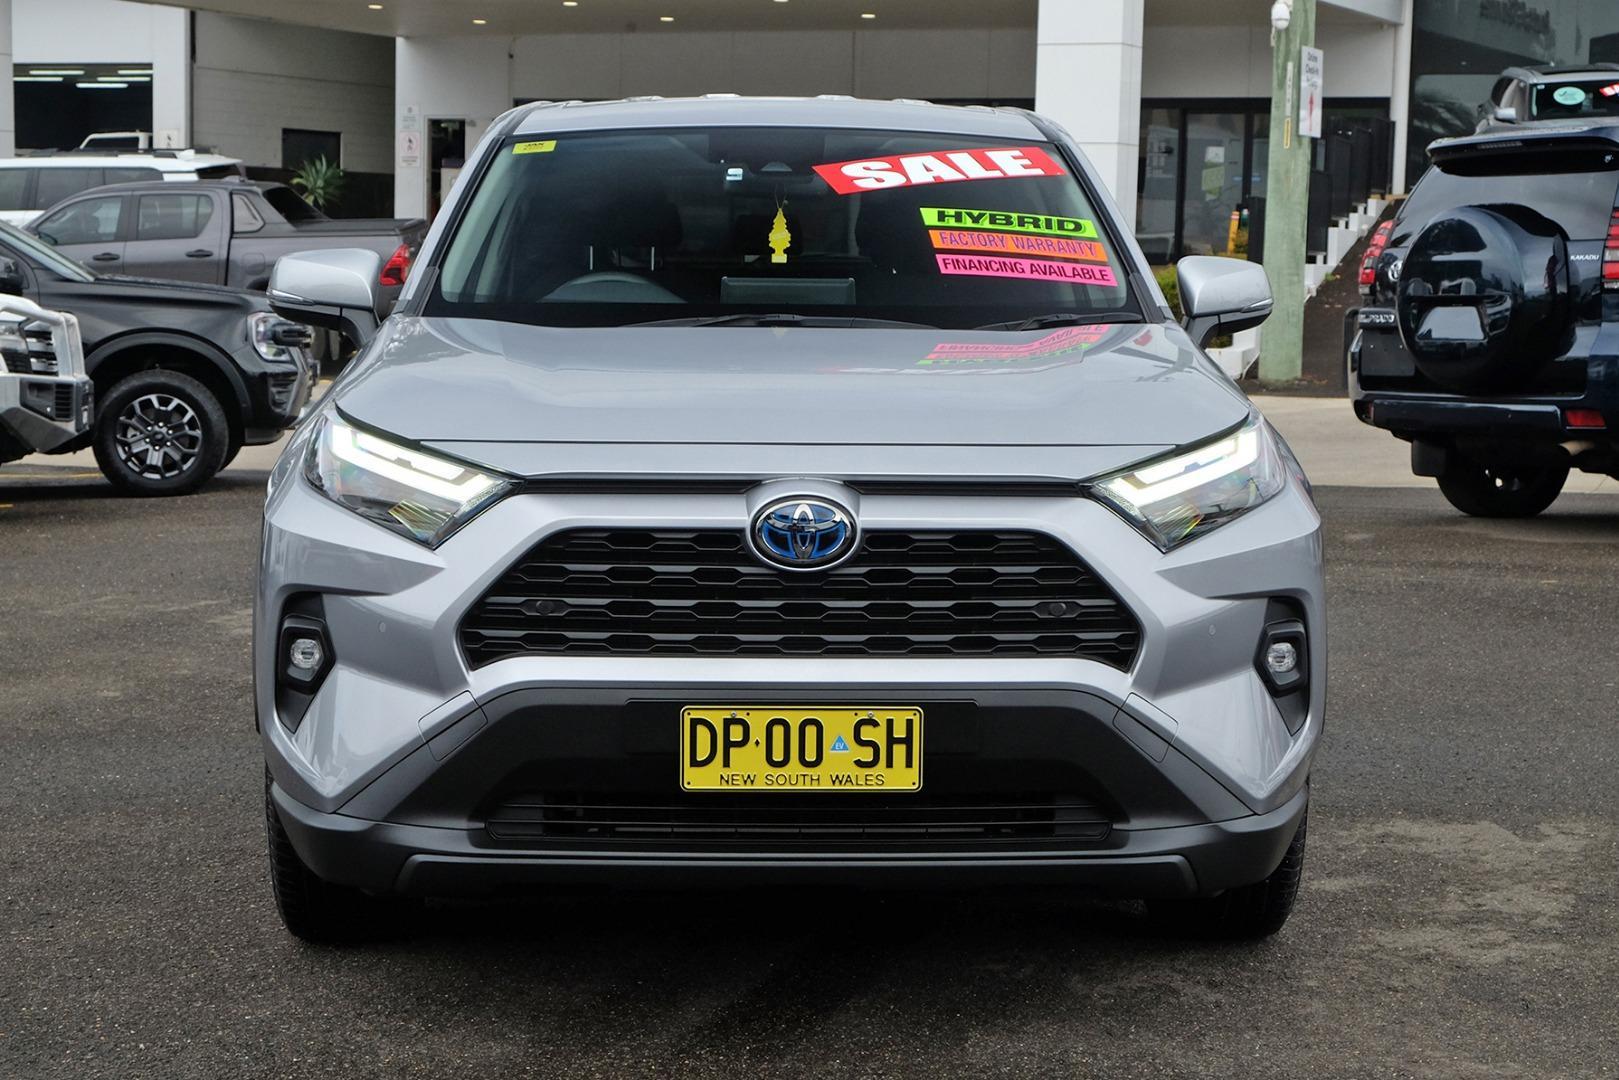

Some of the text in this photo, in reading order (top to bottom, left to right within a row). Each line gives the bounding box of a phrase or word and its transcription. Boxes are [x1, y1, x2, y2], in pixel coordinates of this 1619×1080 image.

[840, 150, 1045, 189] SALE
[937, 210, 1085, 233] HYBRID
[940, 231, 1096, 257] FACTORY WARRANTY
[942, 258, 1111, 282] FINANCING AVAILABLE
[719, 773, 885, 786] NEW SOUTH WALES
